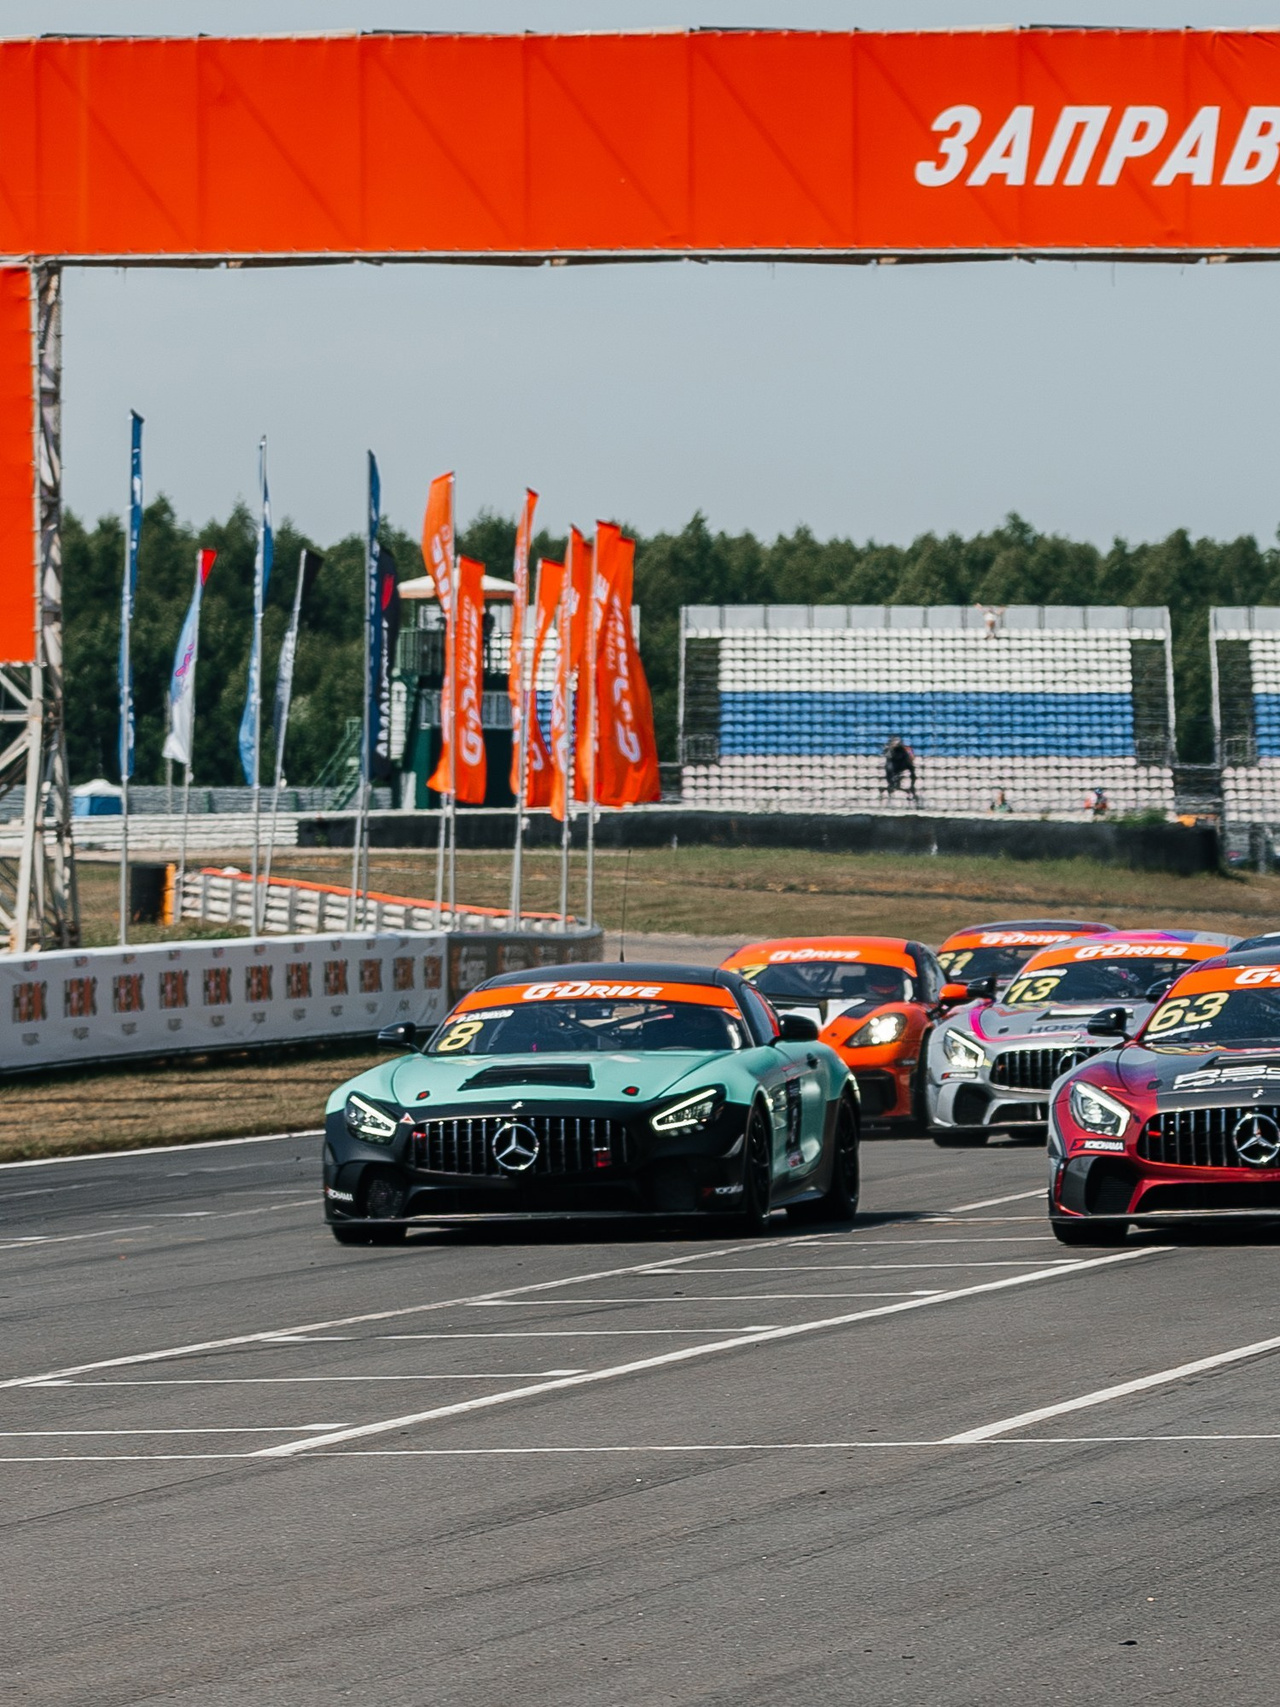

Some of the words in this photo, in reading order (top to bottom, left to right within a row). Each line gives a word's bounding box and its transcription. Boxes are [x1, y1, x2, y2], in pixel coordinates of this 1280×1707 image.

[1008, 977, 1061, 1004] 13
[1147, 991, 1230, 1033] 63
[437, 1021, 484, 1051] 8
